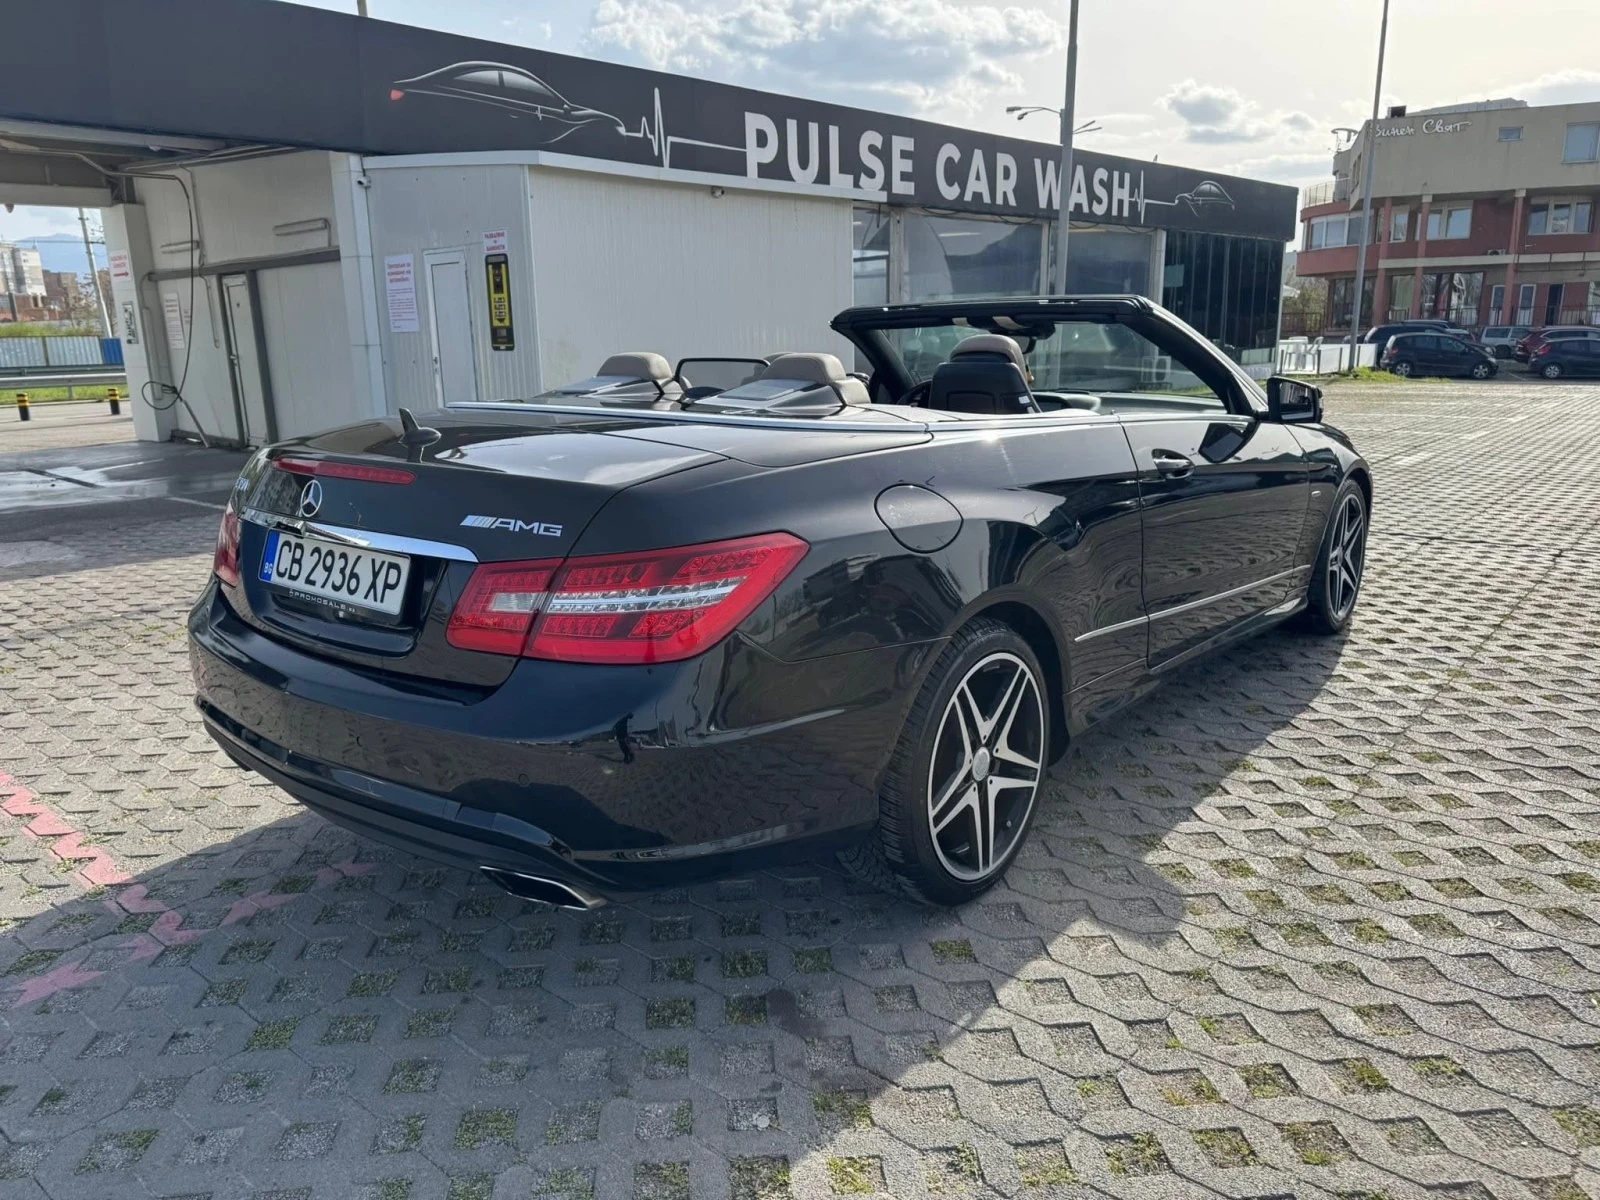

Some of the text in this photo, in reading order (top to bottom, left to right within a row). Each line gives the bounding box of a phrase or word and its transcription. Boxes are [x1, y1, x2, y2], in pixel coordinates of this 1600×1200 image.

[744, 111, 1130, 218] PULSE CAR WASH
[490, 517, 563, 537] AMG
[263, 562, 273, 575] BG
[276, 540, 402, 604] CB 2936 XP
